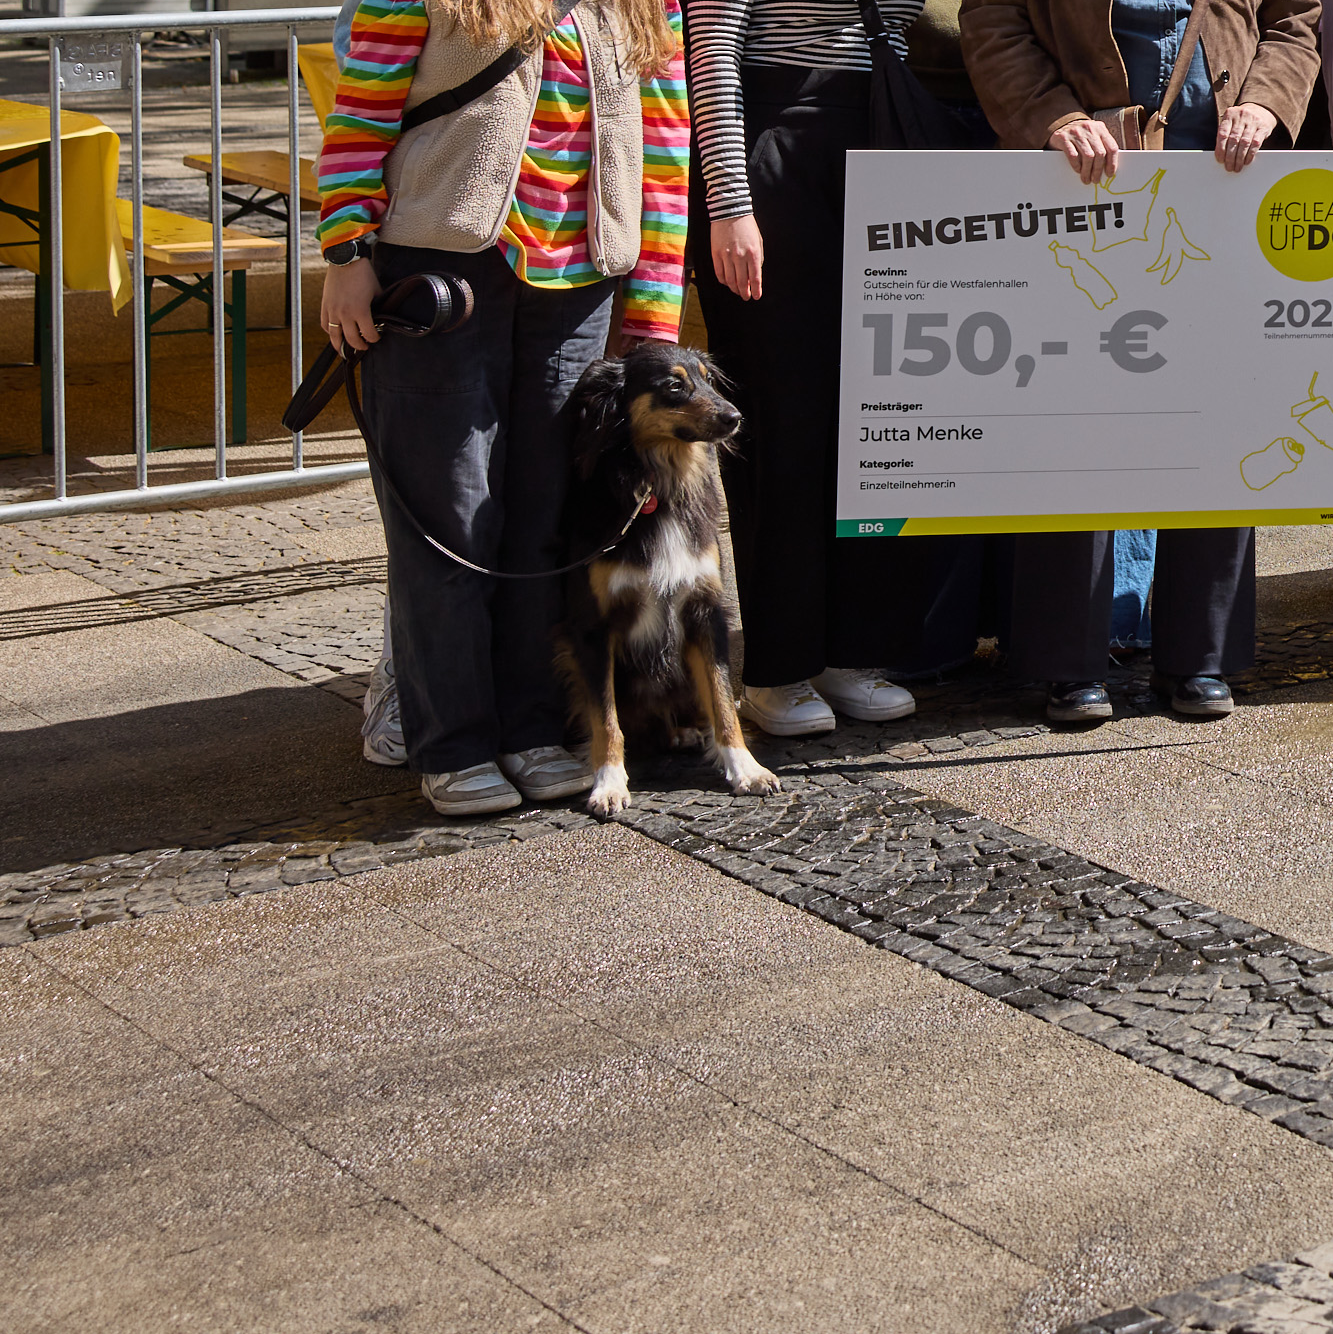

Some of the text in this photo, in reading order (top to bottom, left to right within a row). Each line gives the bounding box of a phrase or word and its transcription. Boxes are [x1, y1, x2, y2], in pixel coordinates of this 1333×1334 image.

[867, 201, 1125, 252] EINGETÜTET!
[864, 267, 908, 278] Gewinn:
[863, 278, 1029, 291] Gutschein für die Westfalenhallen
[863, 291, 925, 302] in Höhe von:
[862, 309, 1168, 389] 150,- €
[861, 401, 923, 414] Preisträger:
[859, 424, 983, 444] Jutta Menke
[859, 458, 914, 471] Kategorie:
[859, 479, 956, 491] Einzelteilnehmer:in
[858, 522, 884, 534] EDG
